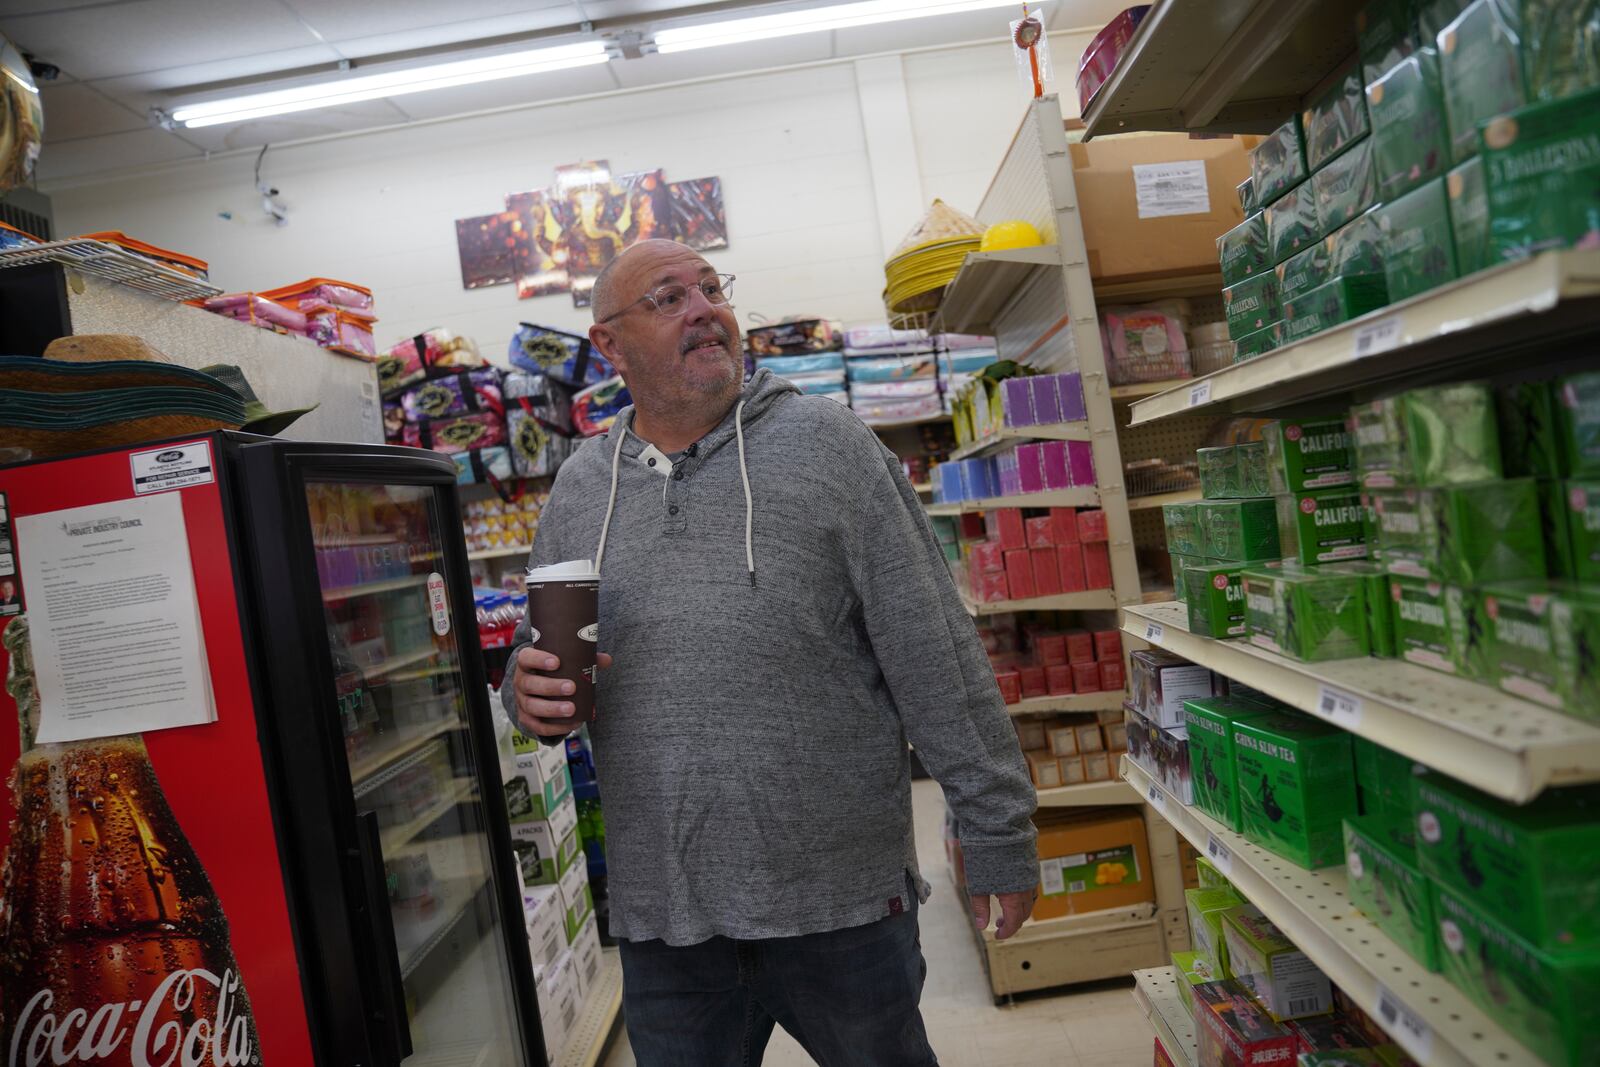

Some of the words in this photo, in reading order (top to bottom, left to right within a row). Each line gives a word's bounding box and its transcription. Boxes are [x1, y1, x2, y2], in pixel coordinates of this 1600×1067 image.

[1300, 432, 1344, 453] CALIFO
[512, 735, 531, 746] EW
[1234, 732, 1258, 751] CHINA
[1259, 740, 1278, 757] SLIM
[1279, 747, 1296, 763] TEA
[9, 968, 250, 1067] Coca-Cola
